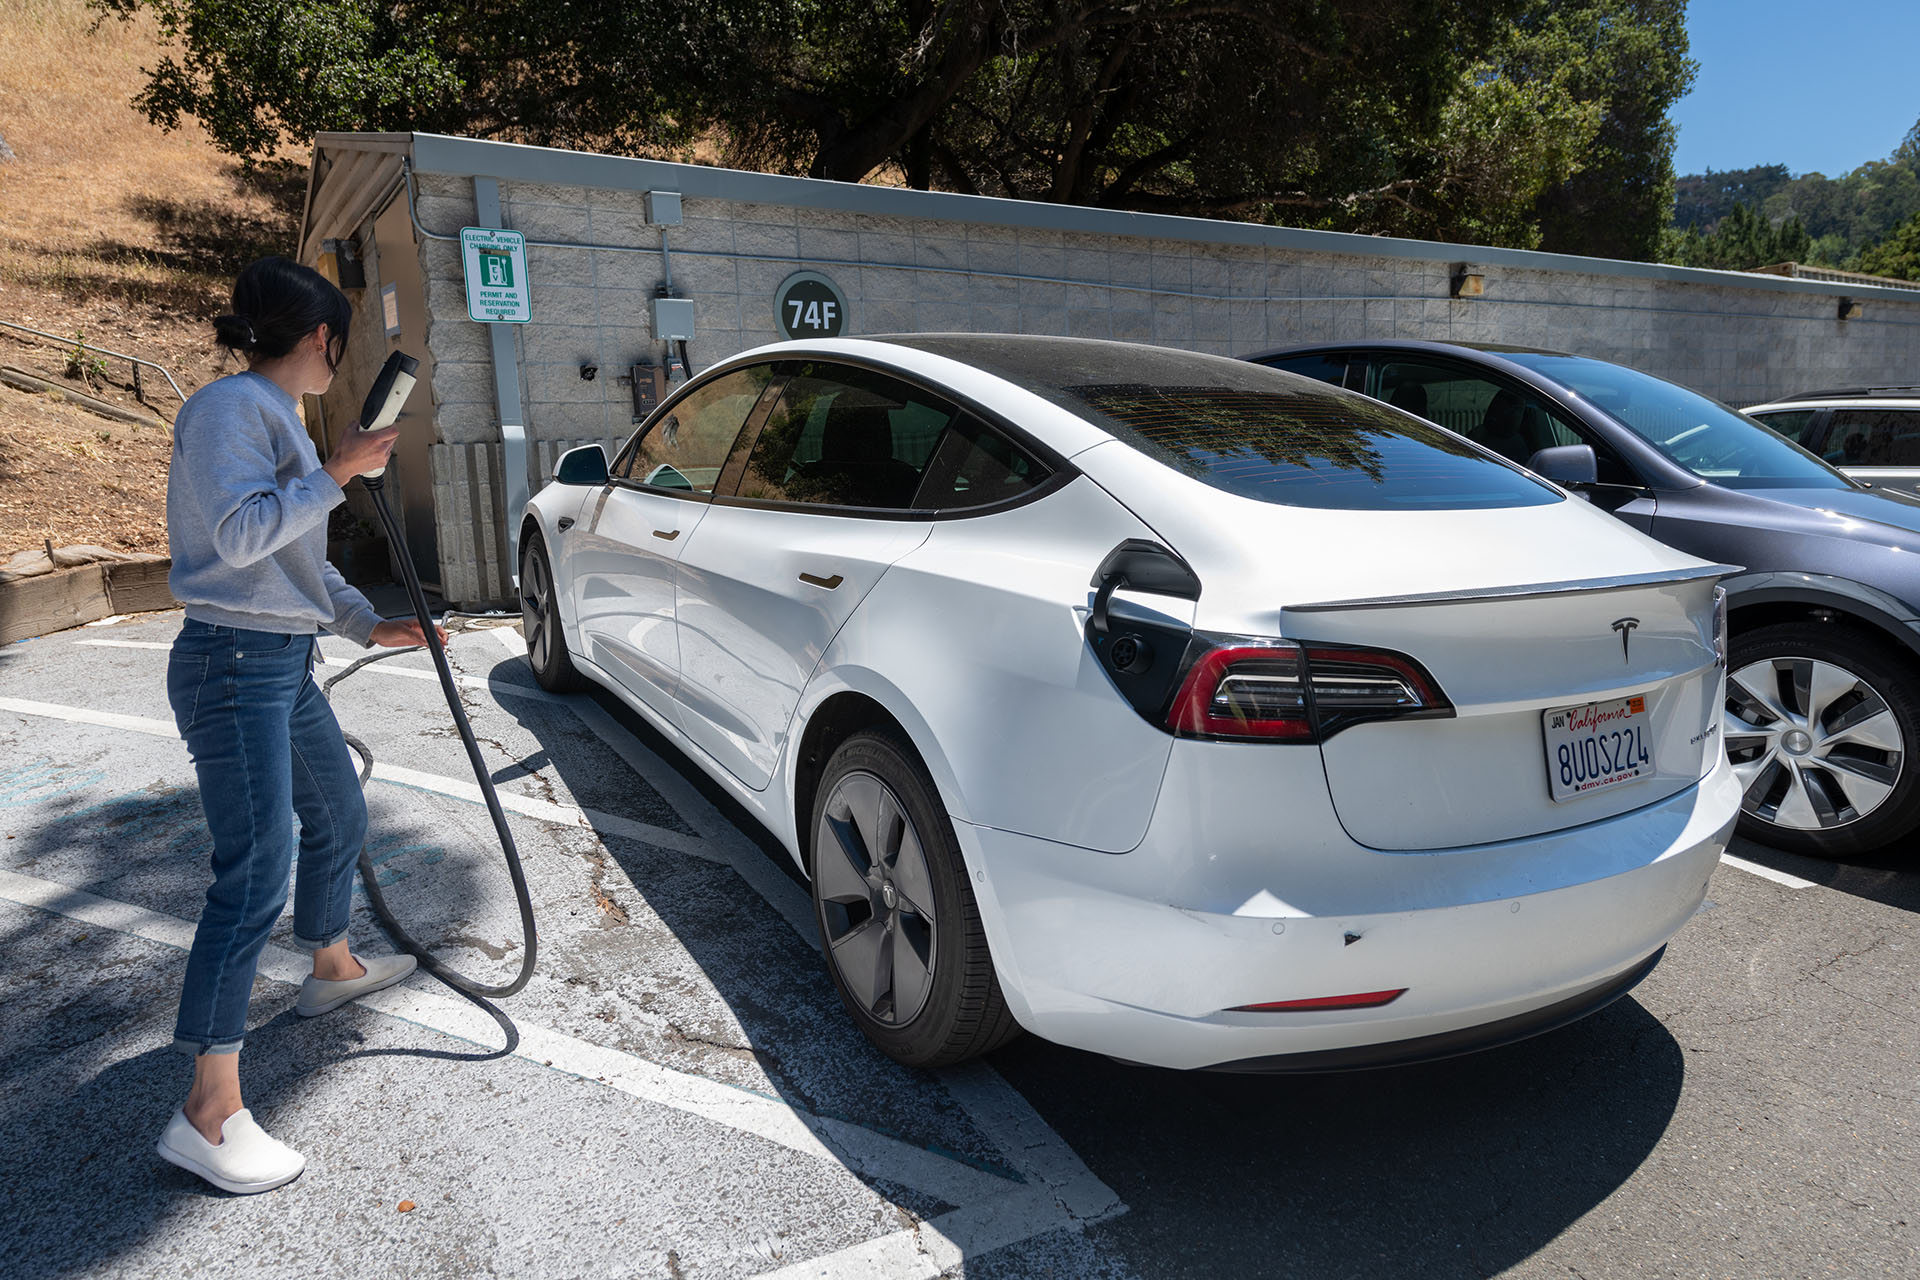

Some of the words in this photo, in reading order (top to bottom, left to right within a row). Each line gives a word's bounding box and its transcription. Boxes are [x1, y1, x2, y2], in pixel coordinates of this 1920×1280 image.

[503, 244, 518, 252] ONLY
[480, 299, 520, 307] RESERVATION
[788, 300, 836, 329] 74F
[1552, 715, 1565, 729] JAN
[1569, 704, 1632, 733] California
[1581, 772, 1633, 790] dmv.ca.gov
